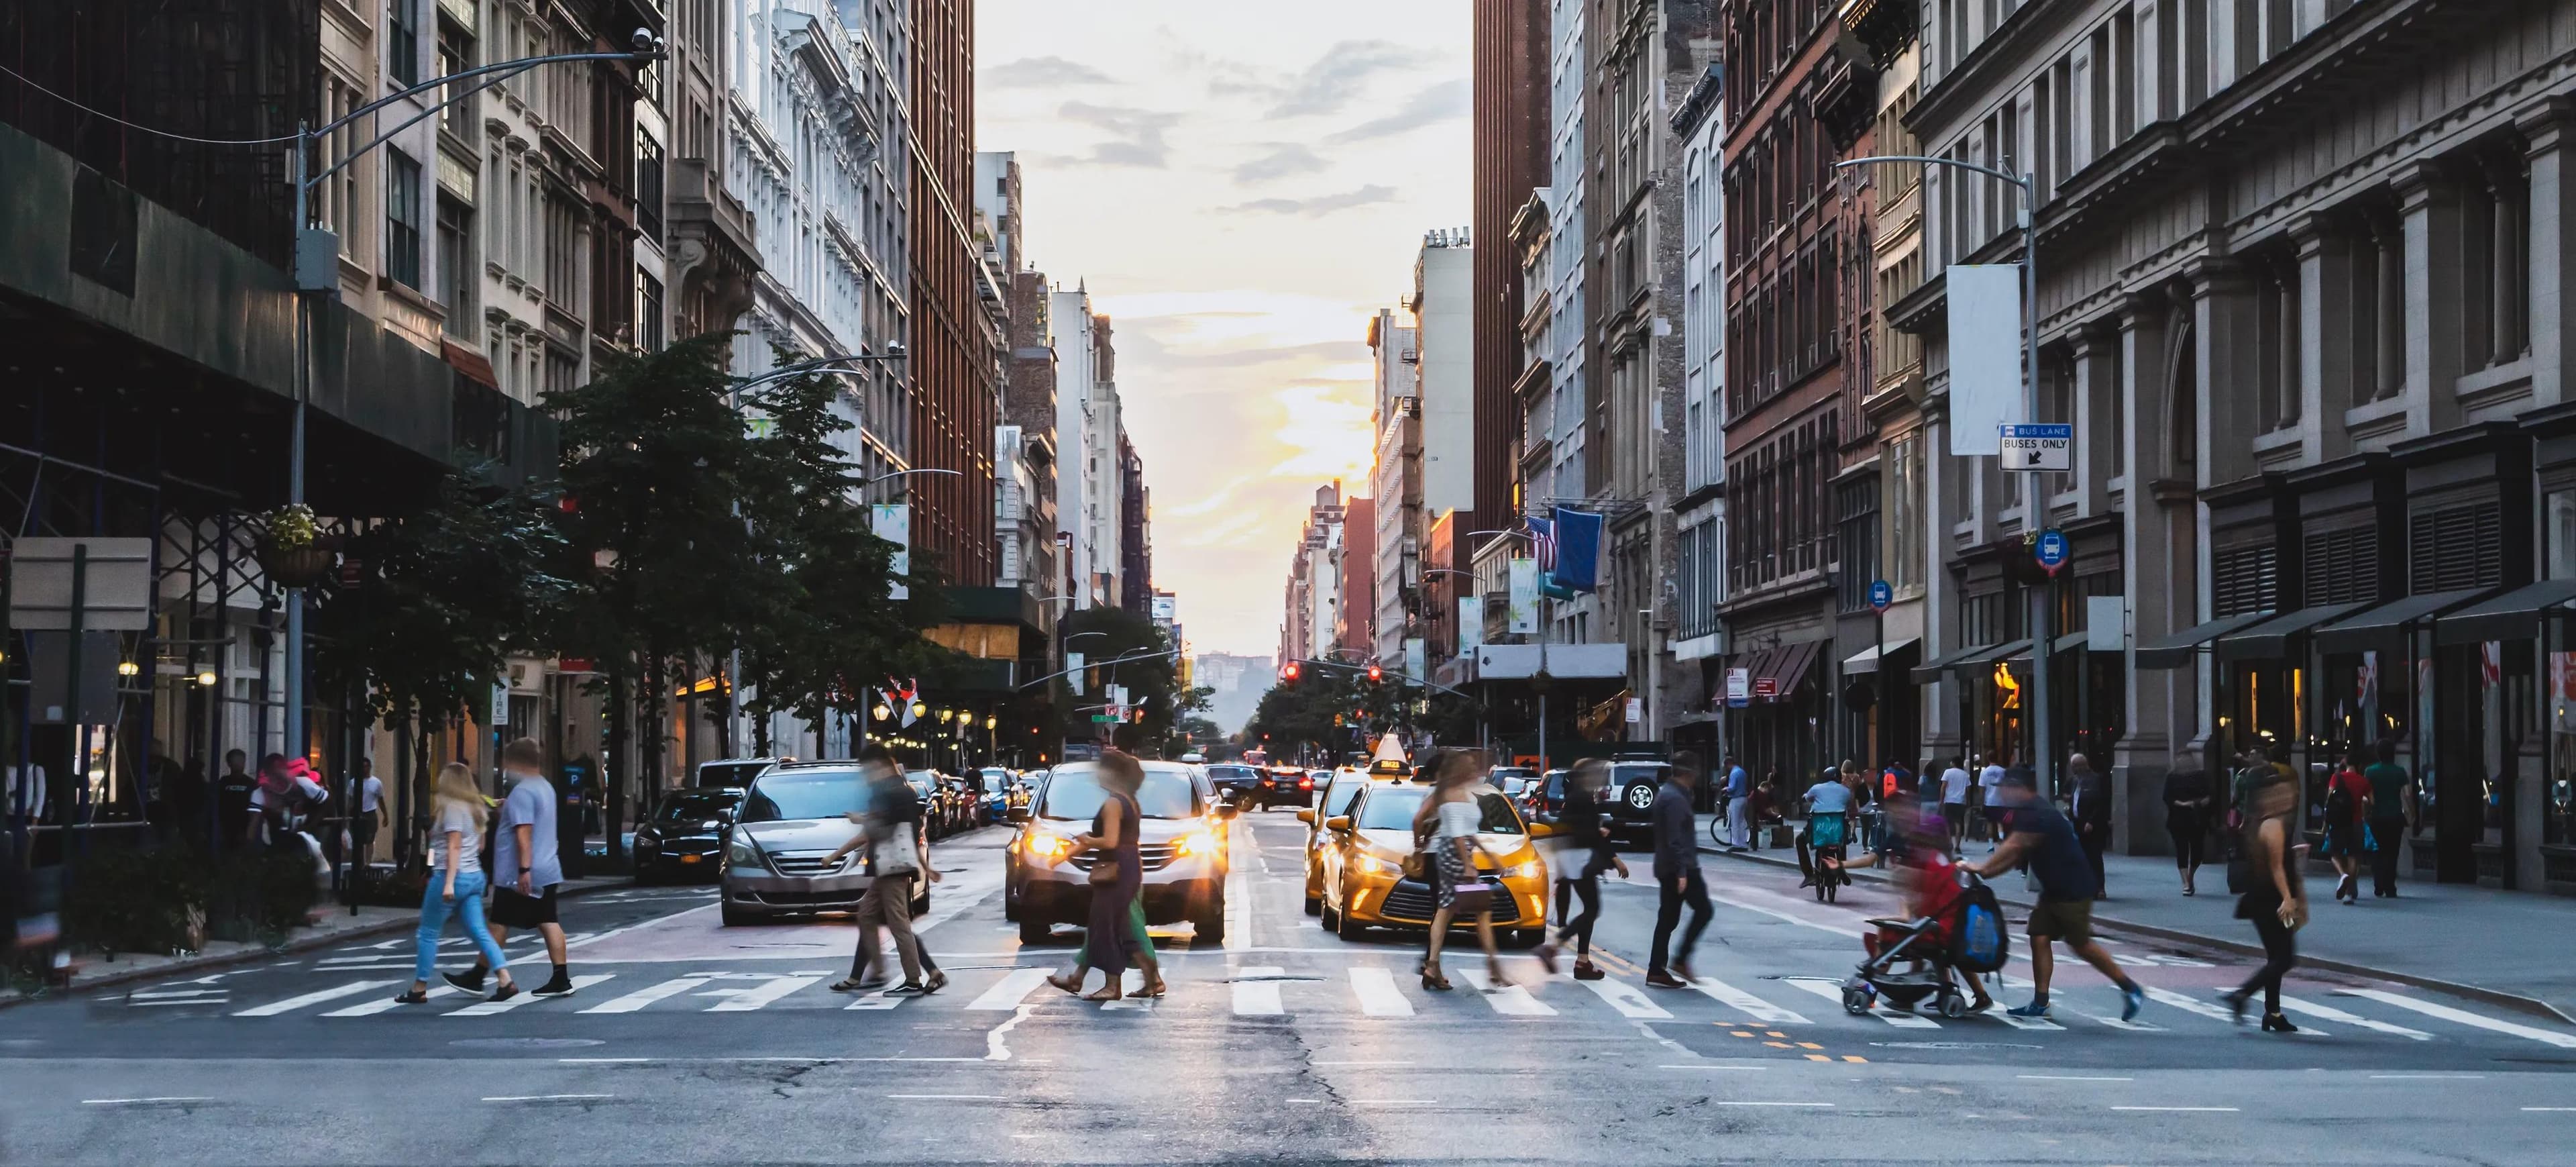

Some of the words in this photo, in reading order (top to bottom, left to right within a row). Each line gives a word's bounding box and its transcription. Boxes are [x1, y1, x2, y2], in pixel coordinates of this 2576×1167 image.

[2004, 440, 2037, 448] BUSES
[2042, 440, 2067, 448] ONLY
[571, 774, 578, 784] P
